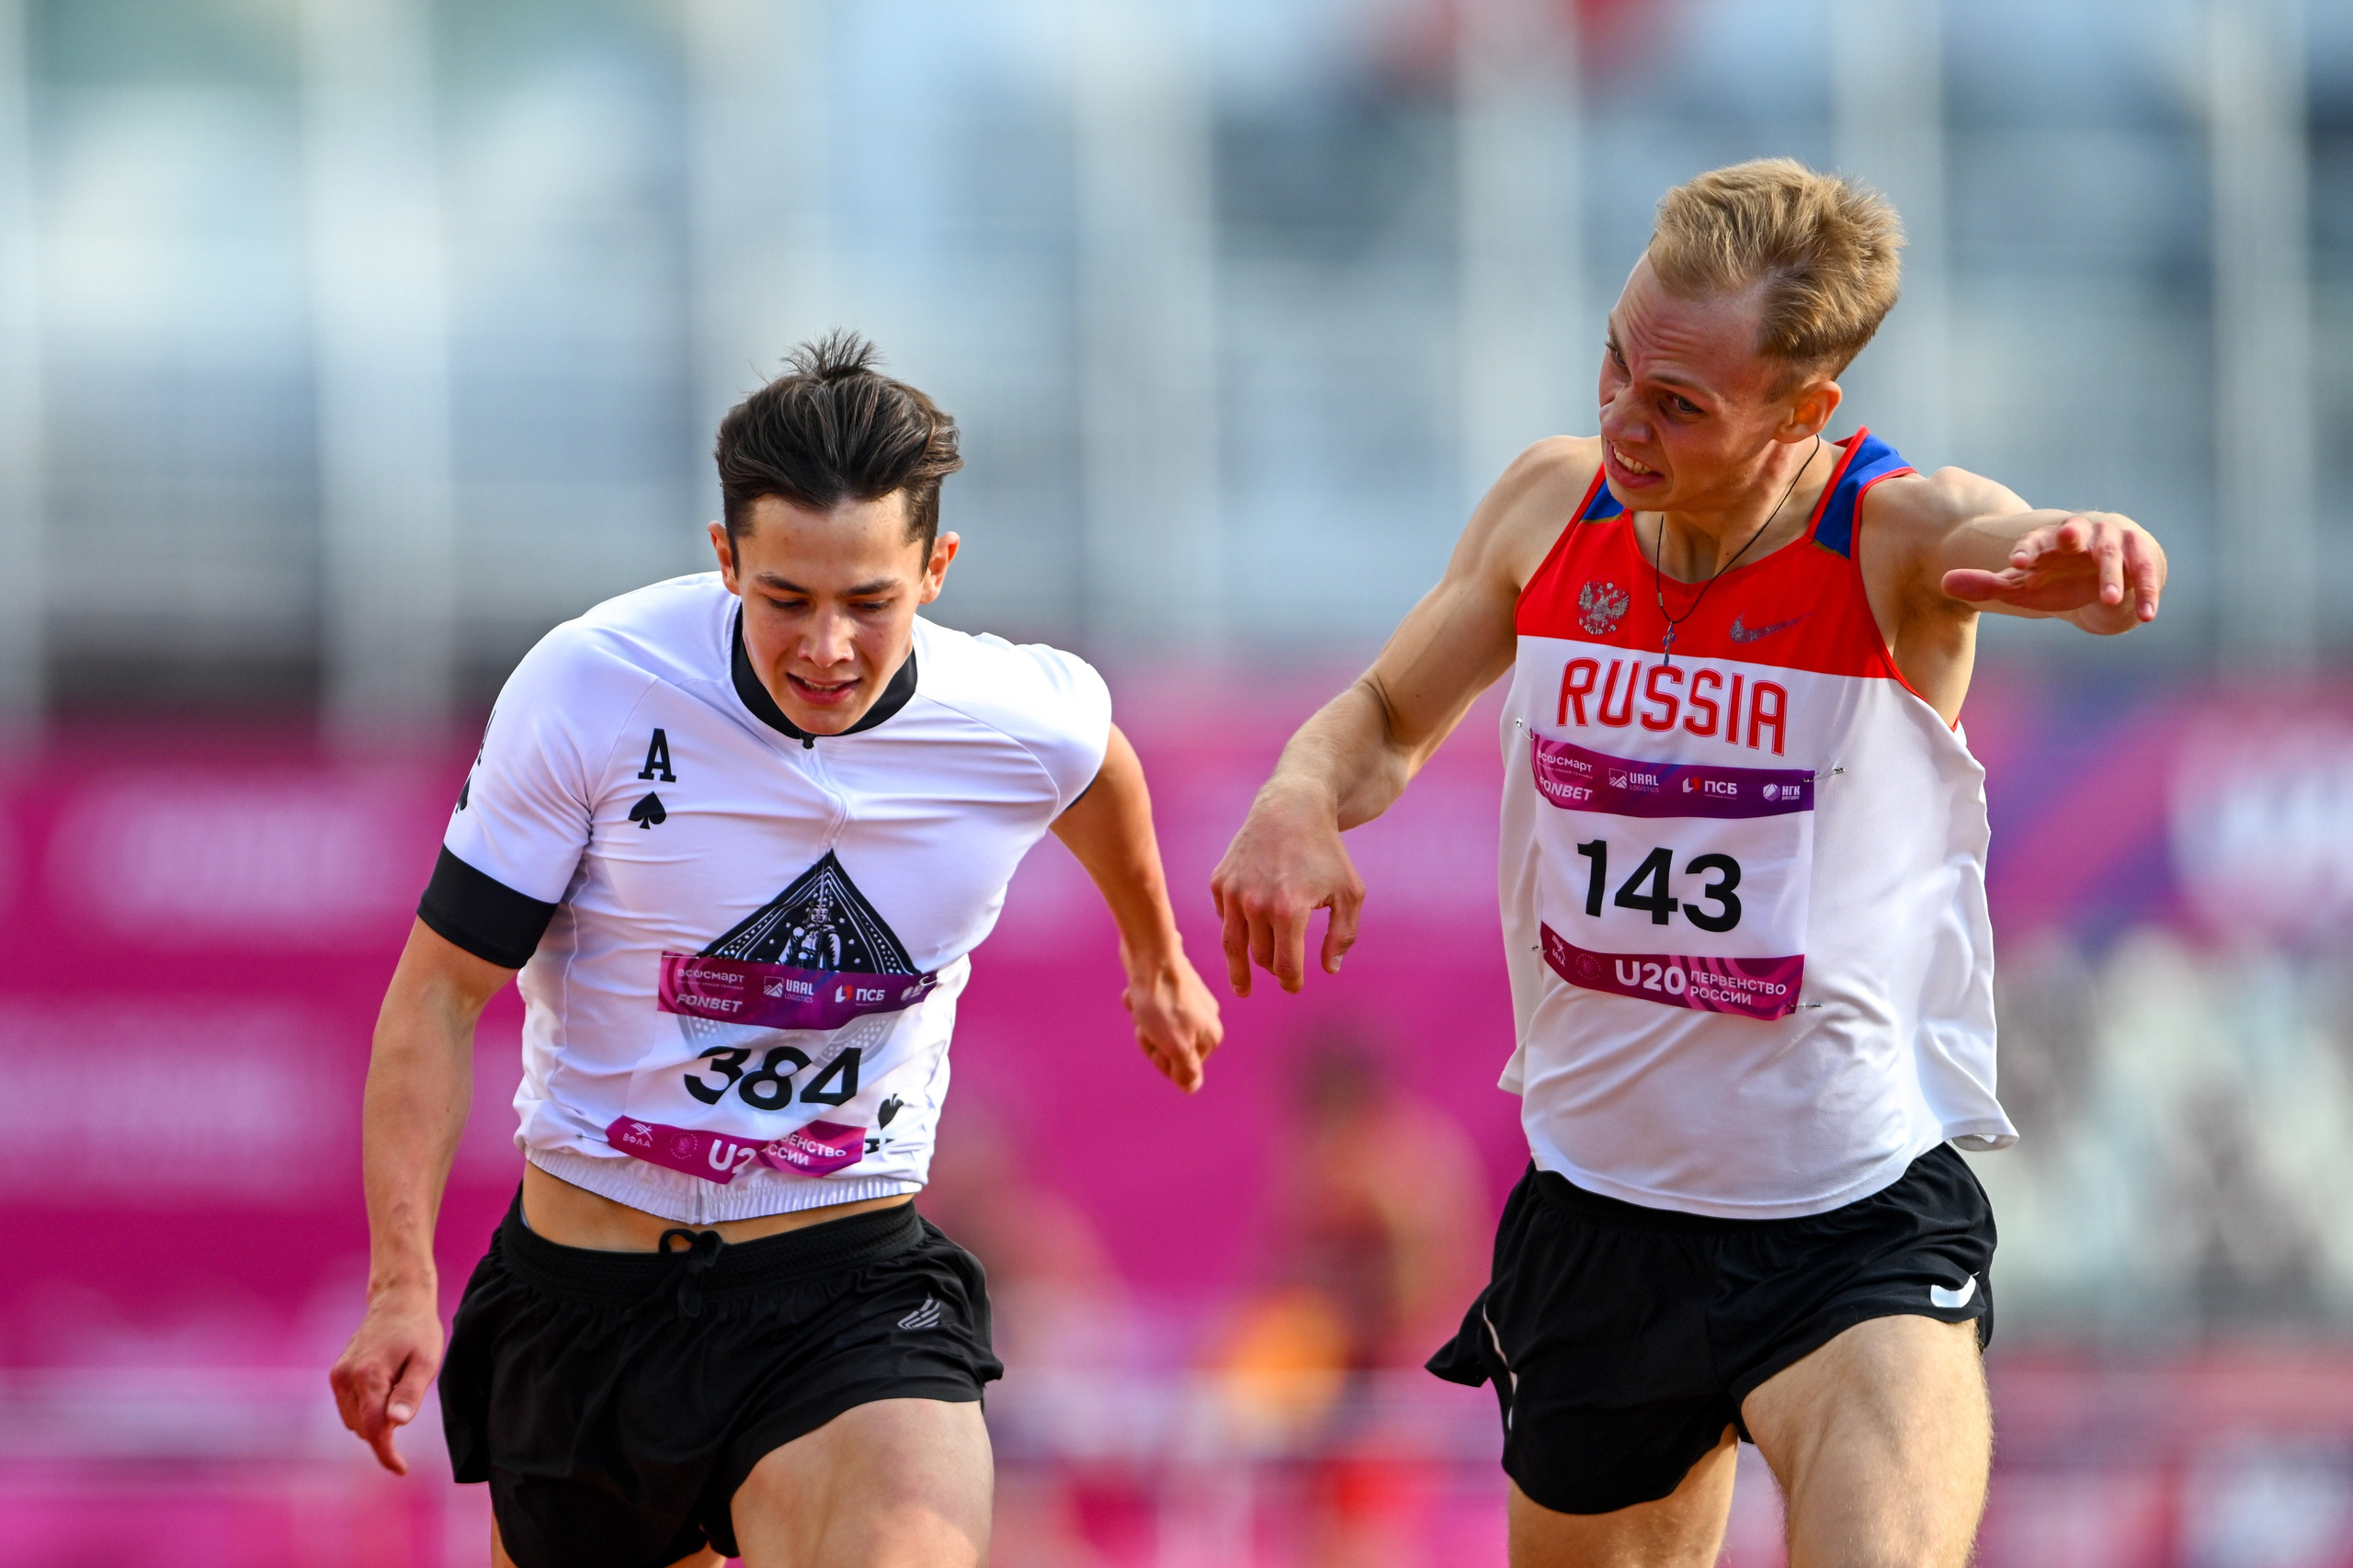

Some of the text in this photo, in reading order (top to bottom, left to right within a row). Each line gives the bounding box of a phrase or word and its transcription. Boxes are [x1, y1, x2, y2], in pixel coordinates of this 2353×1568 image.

[1556, 656, 1788, 756] RUSSIA
[638, 728, 676, 783] A
[1540, 776, 1593, 801] FONBET
[1630, 772, 1659, 786] URAL
[1704, 780, 1737, 794] ПСБ
[1781, 785, 1801, 796] НГК
[1577, 839, 1743, 933] 143
[785, 979, 813, 995] URAL
[1615, 959, 1687, 995] U20
[1690, 970, 1787, 995] ПЕРВЕНСТВО
[676, 994, 743, 1012] FONBET
[784, 993, 813, 1003] LOGISTICS
[856, 988, 885, 1001] ПСБ
[1690, 987, 1752, 1006] РОССИИ
[684, 1046, 862, 1110] 384
[622, 1133, 651, 1148] ВФЛА
[708, 1139, 756, 1174] U2
[767, 1143, 809, 1165] ССИИ
